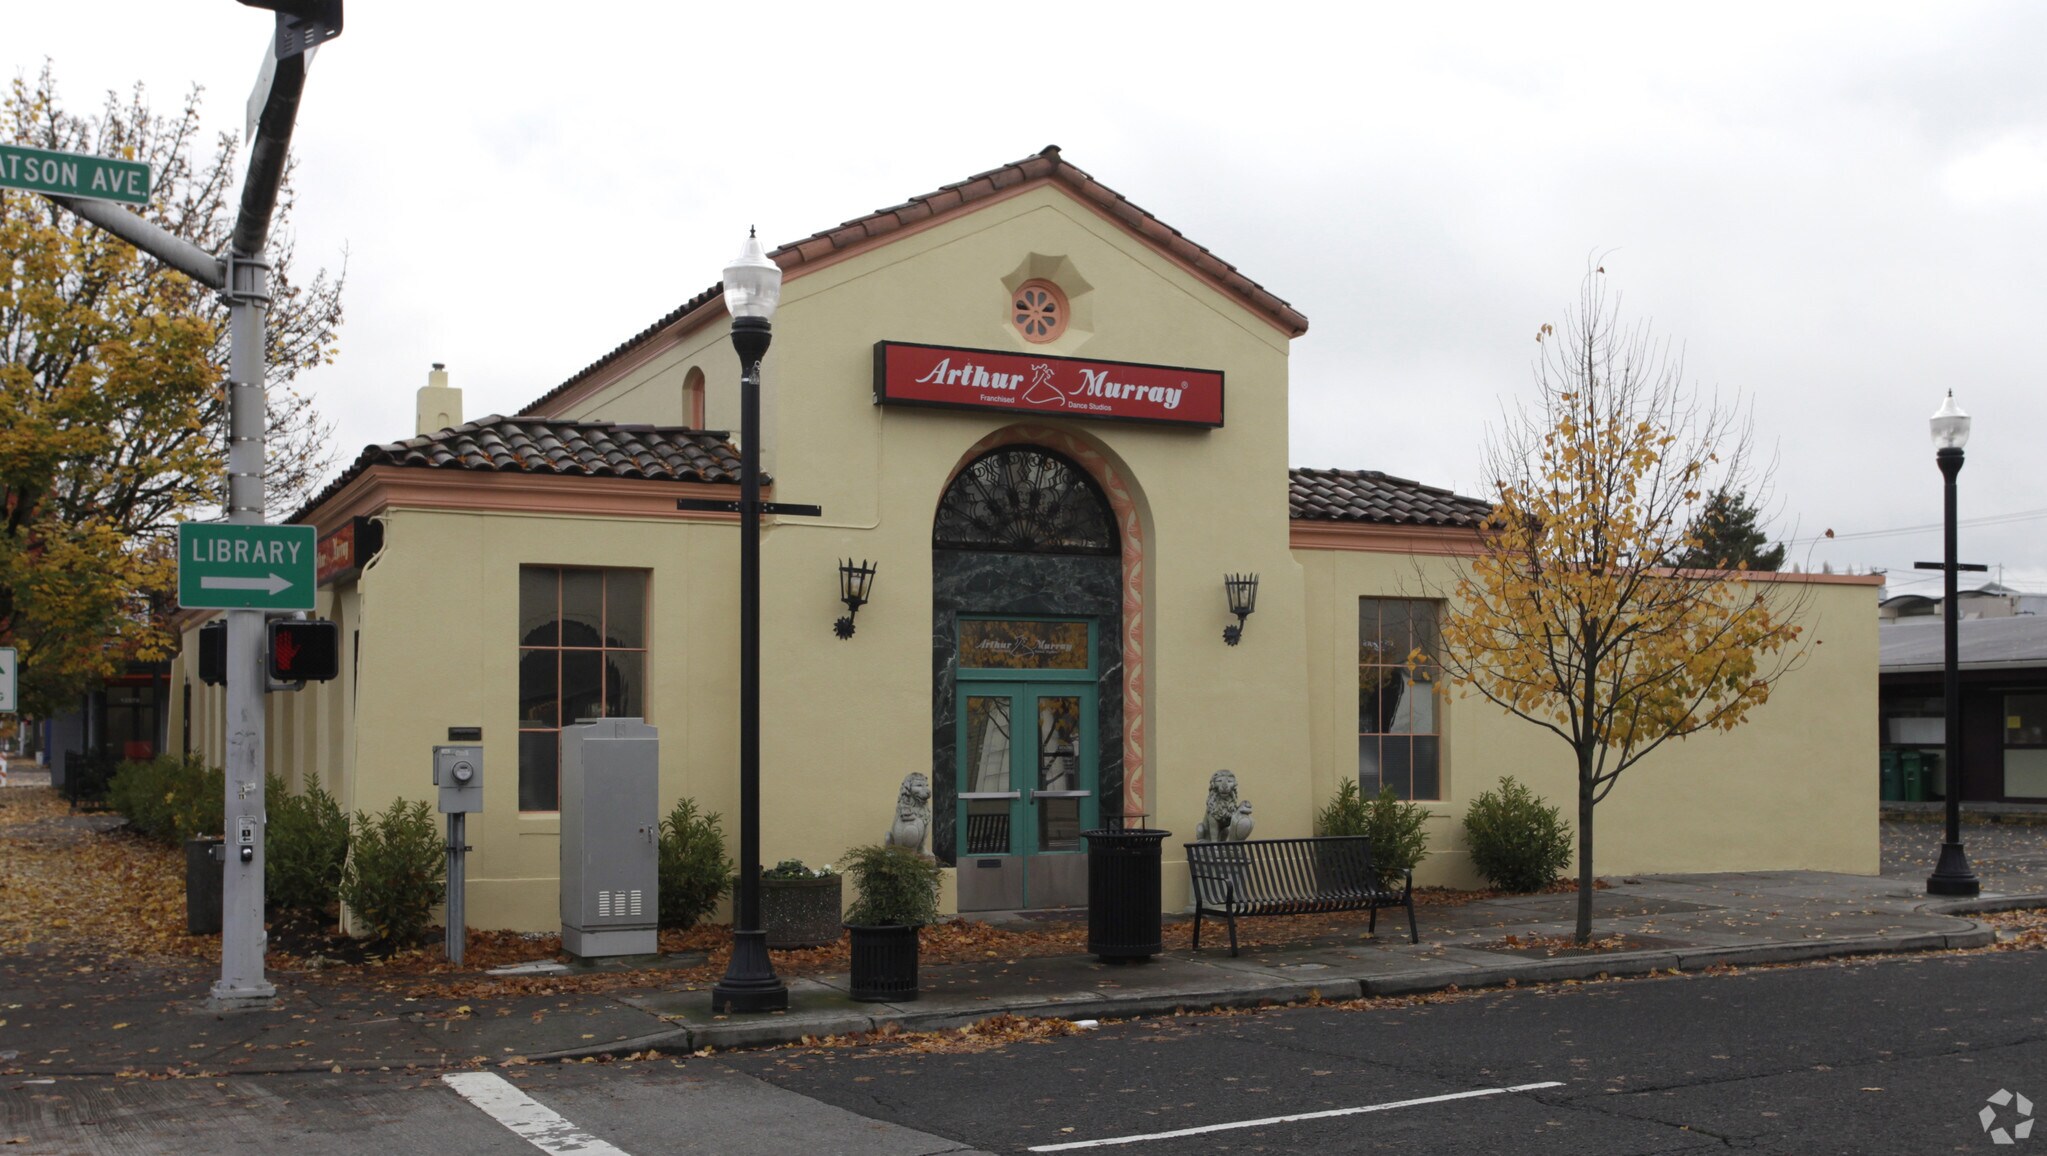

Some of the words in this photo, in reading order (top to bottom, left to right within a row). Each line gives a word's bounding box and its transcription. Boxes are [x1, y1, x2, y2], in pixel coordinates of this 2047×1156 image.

[91, 166, 147, 197] AVE.
[915, 357, 1024, 390] Arthur
[980, 394, 1015, 404] Franchised
[1068, 401, 1088, 410] Dance
[1089, 402, 1112, 411] Studios
[192, 538, 302, 564] LIBRARY
[976, 638, 1012, 649] Arthur
[1034, 639, 1073, 652] Murray
